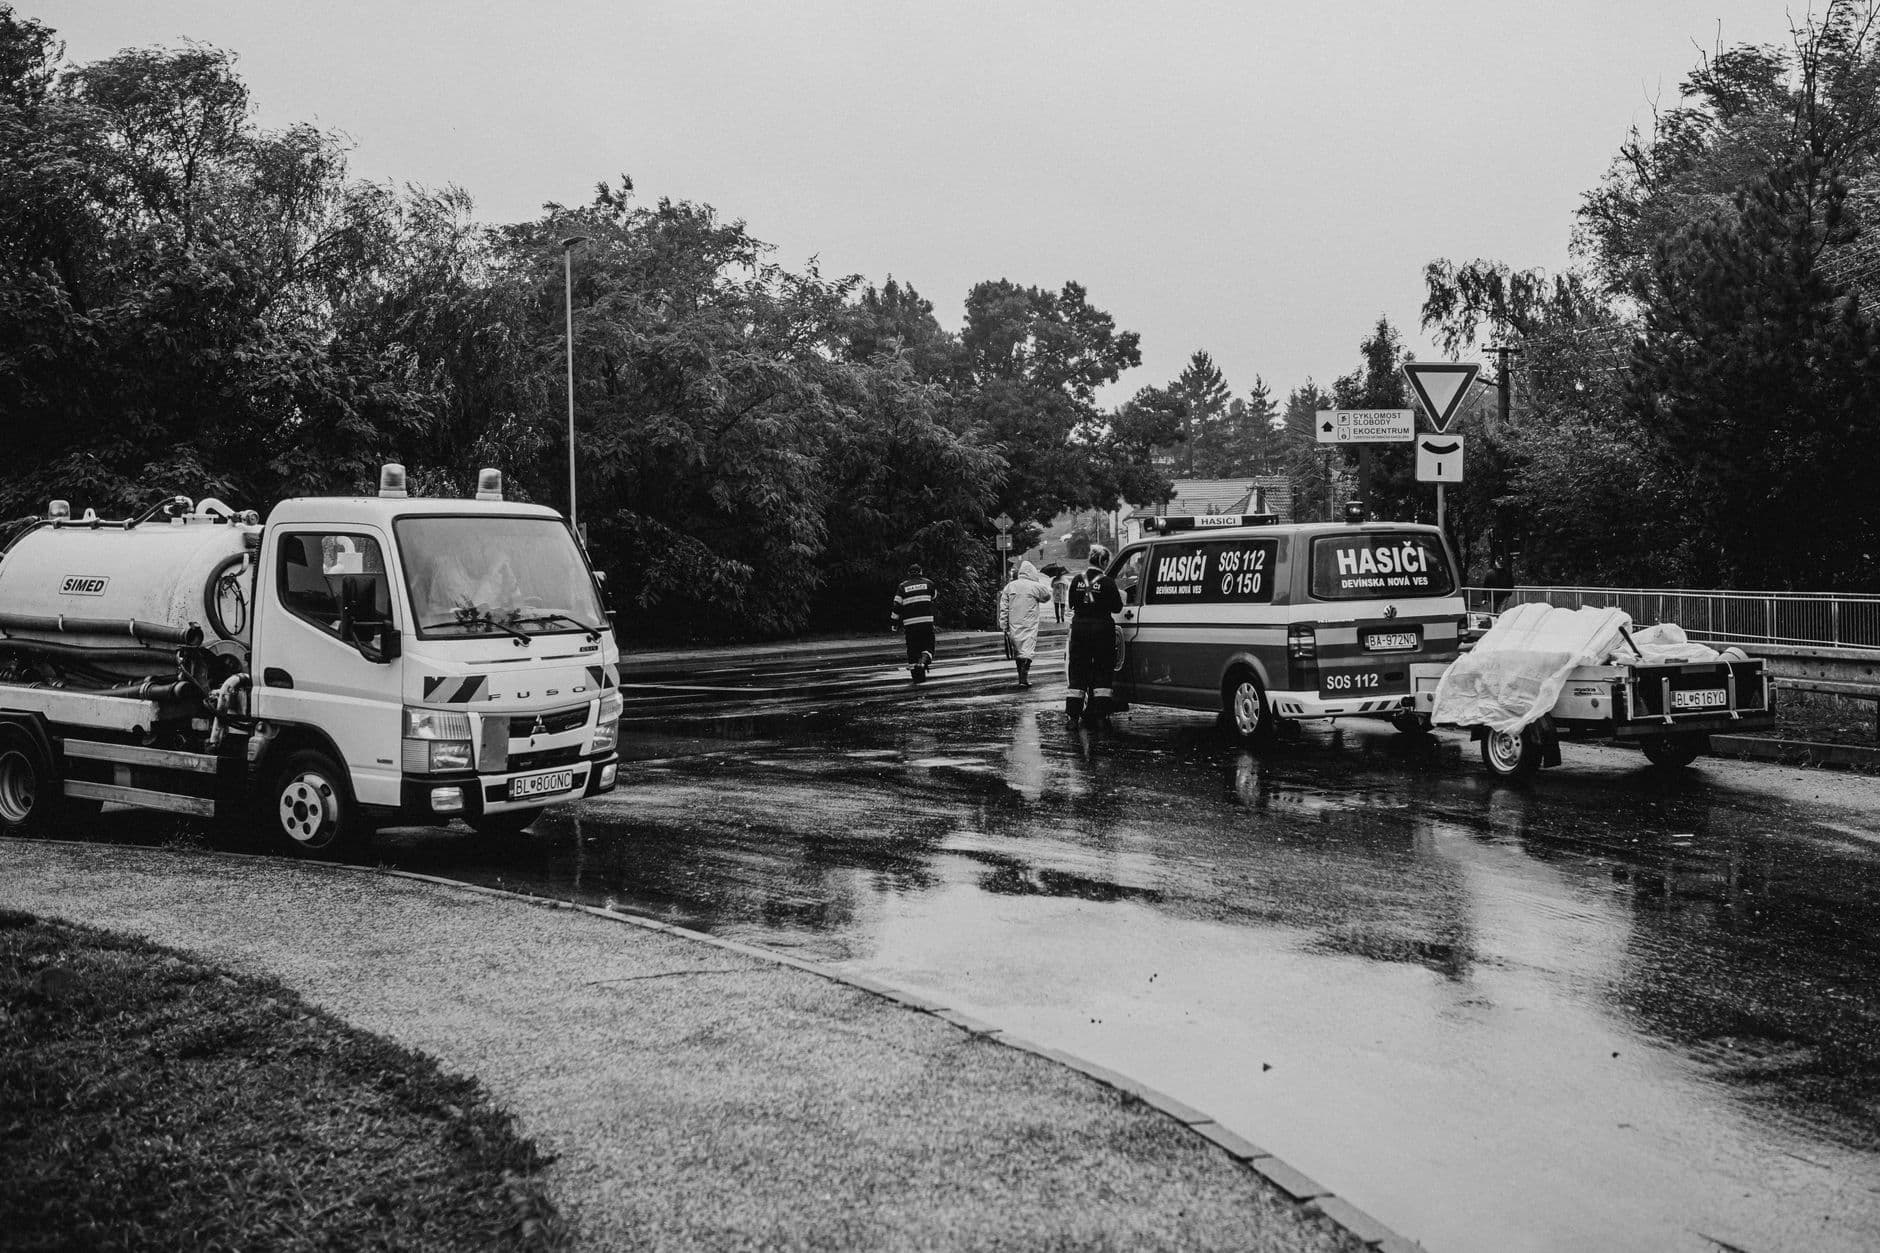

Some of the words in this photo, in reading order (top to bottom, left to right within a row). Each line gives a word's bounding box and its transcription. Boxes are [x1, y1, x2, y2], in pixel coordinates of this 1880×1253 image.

[1353, 427, 1410, 435] EKOCENTRUM
[1157, 549, 1207, 582] HASIČI
[1218, 551, 1241, 572] SOS
[1243, 550, 1266, 571] 112
[1336, 541, 1427, 575] HASIČI
[63, 578, 105, 592] SIMED
[1236, 573, 1261, 594] 150
[1341, 576, 1385, 588] DEVÍNSKA
[1388, 575, 1410, 586] NOVÁ
[1412, 576, 1428, 586] VES
[1327, 675, 1351, 690] SOS
[1355, 673, 1379, 688] 112
[488, 686, 586, 701] FUSO
